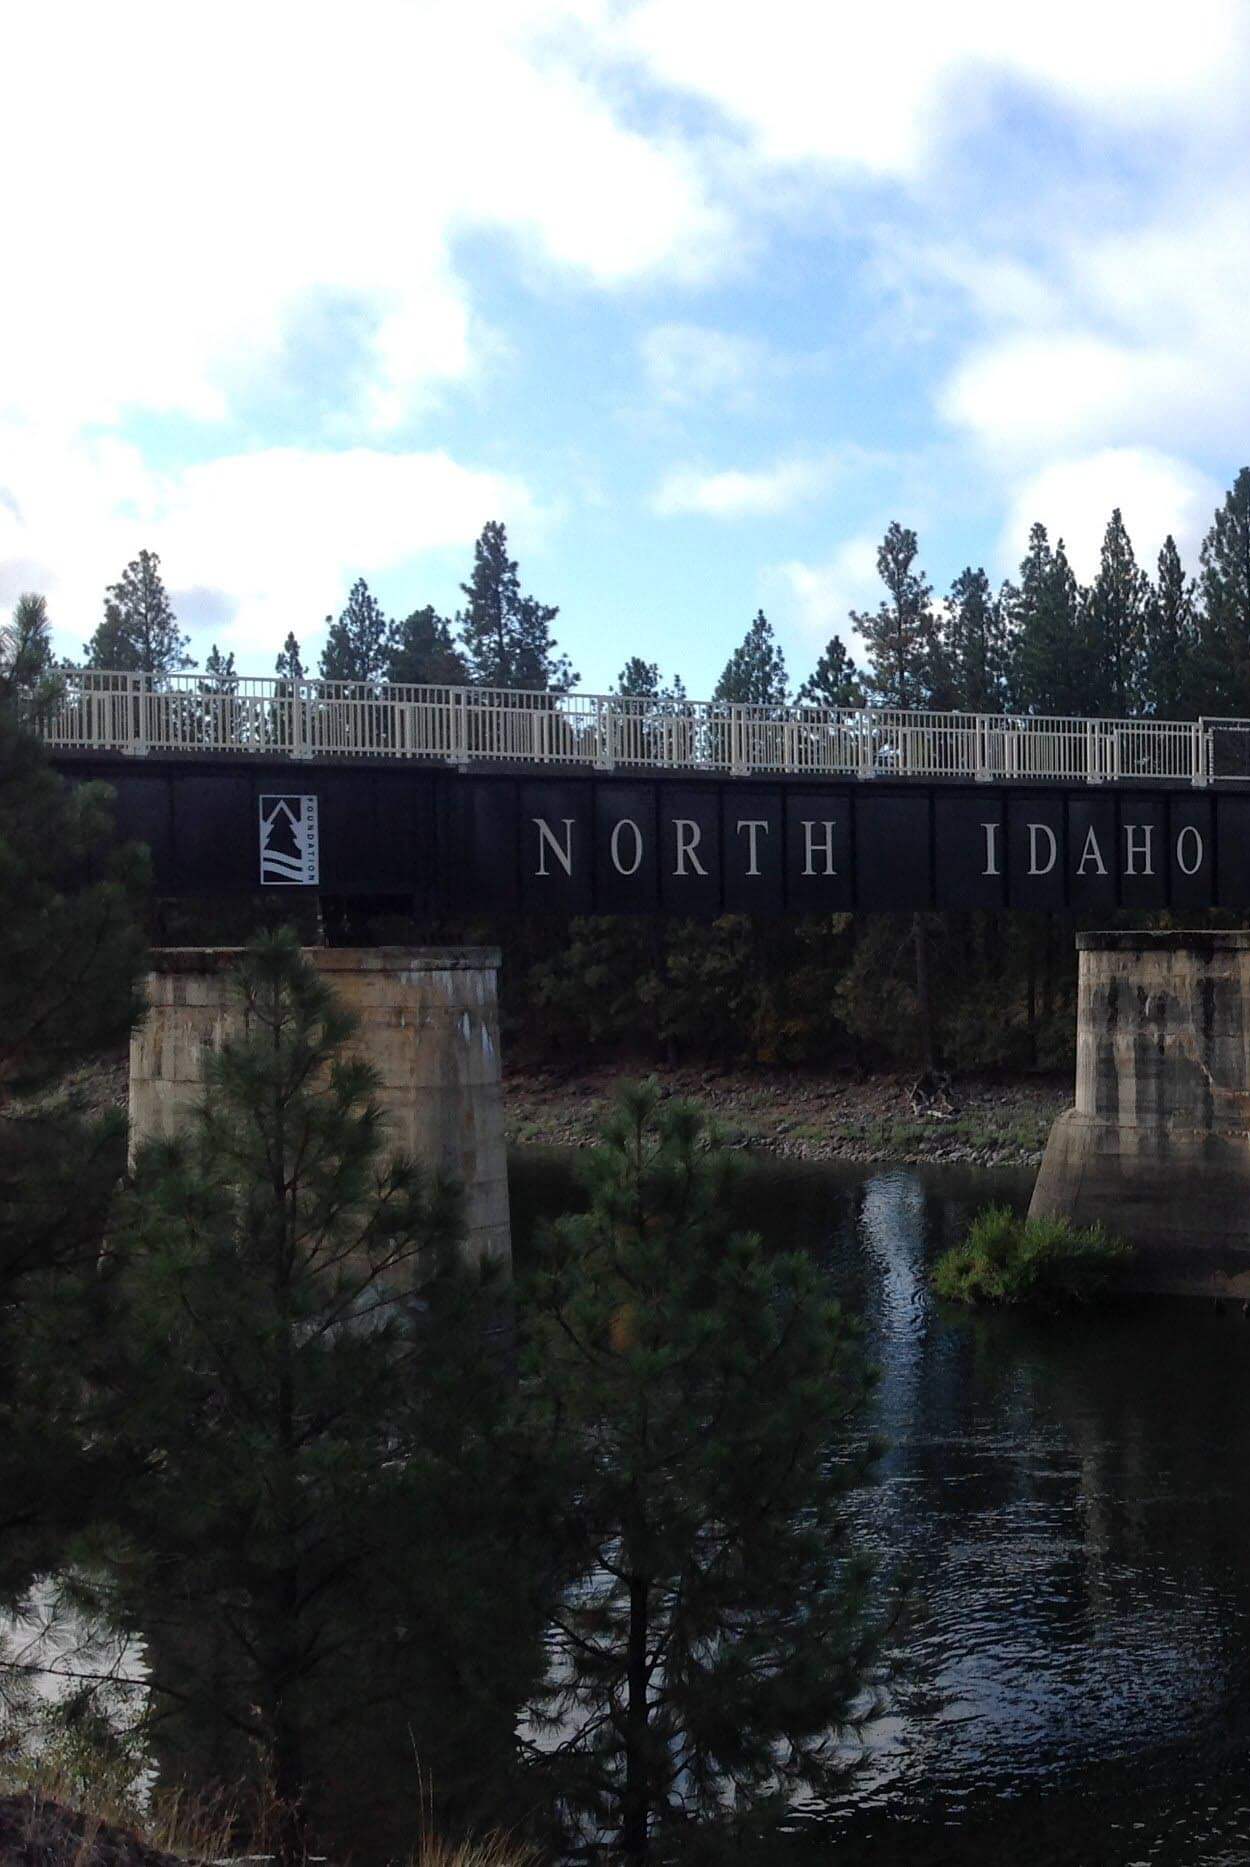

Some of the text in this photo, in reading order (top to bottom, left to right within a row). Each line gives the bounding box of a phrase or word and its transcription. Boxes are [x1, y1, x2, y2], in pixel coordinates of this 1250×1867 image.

[306, 798, 316, 881] FOUNDATION
[533, 818, 837, 876] NORTH
[980, 823, 1204, 876] IDAHO
